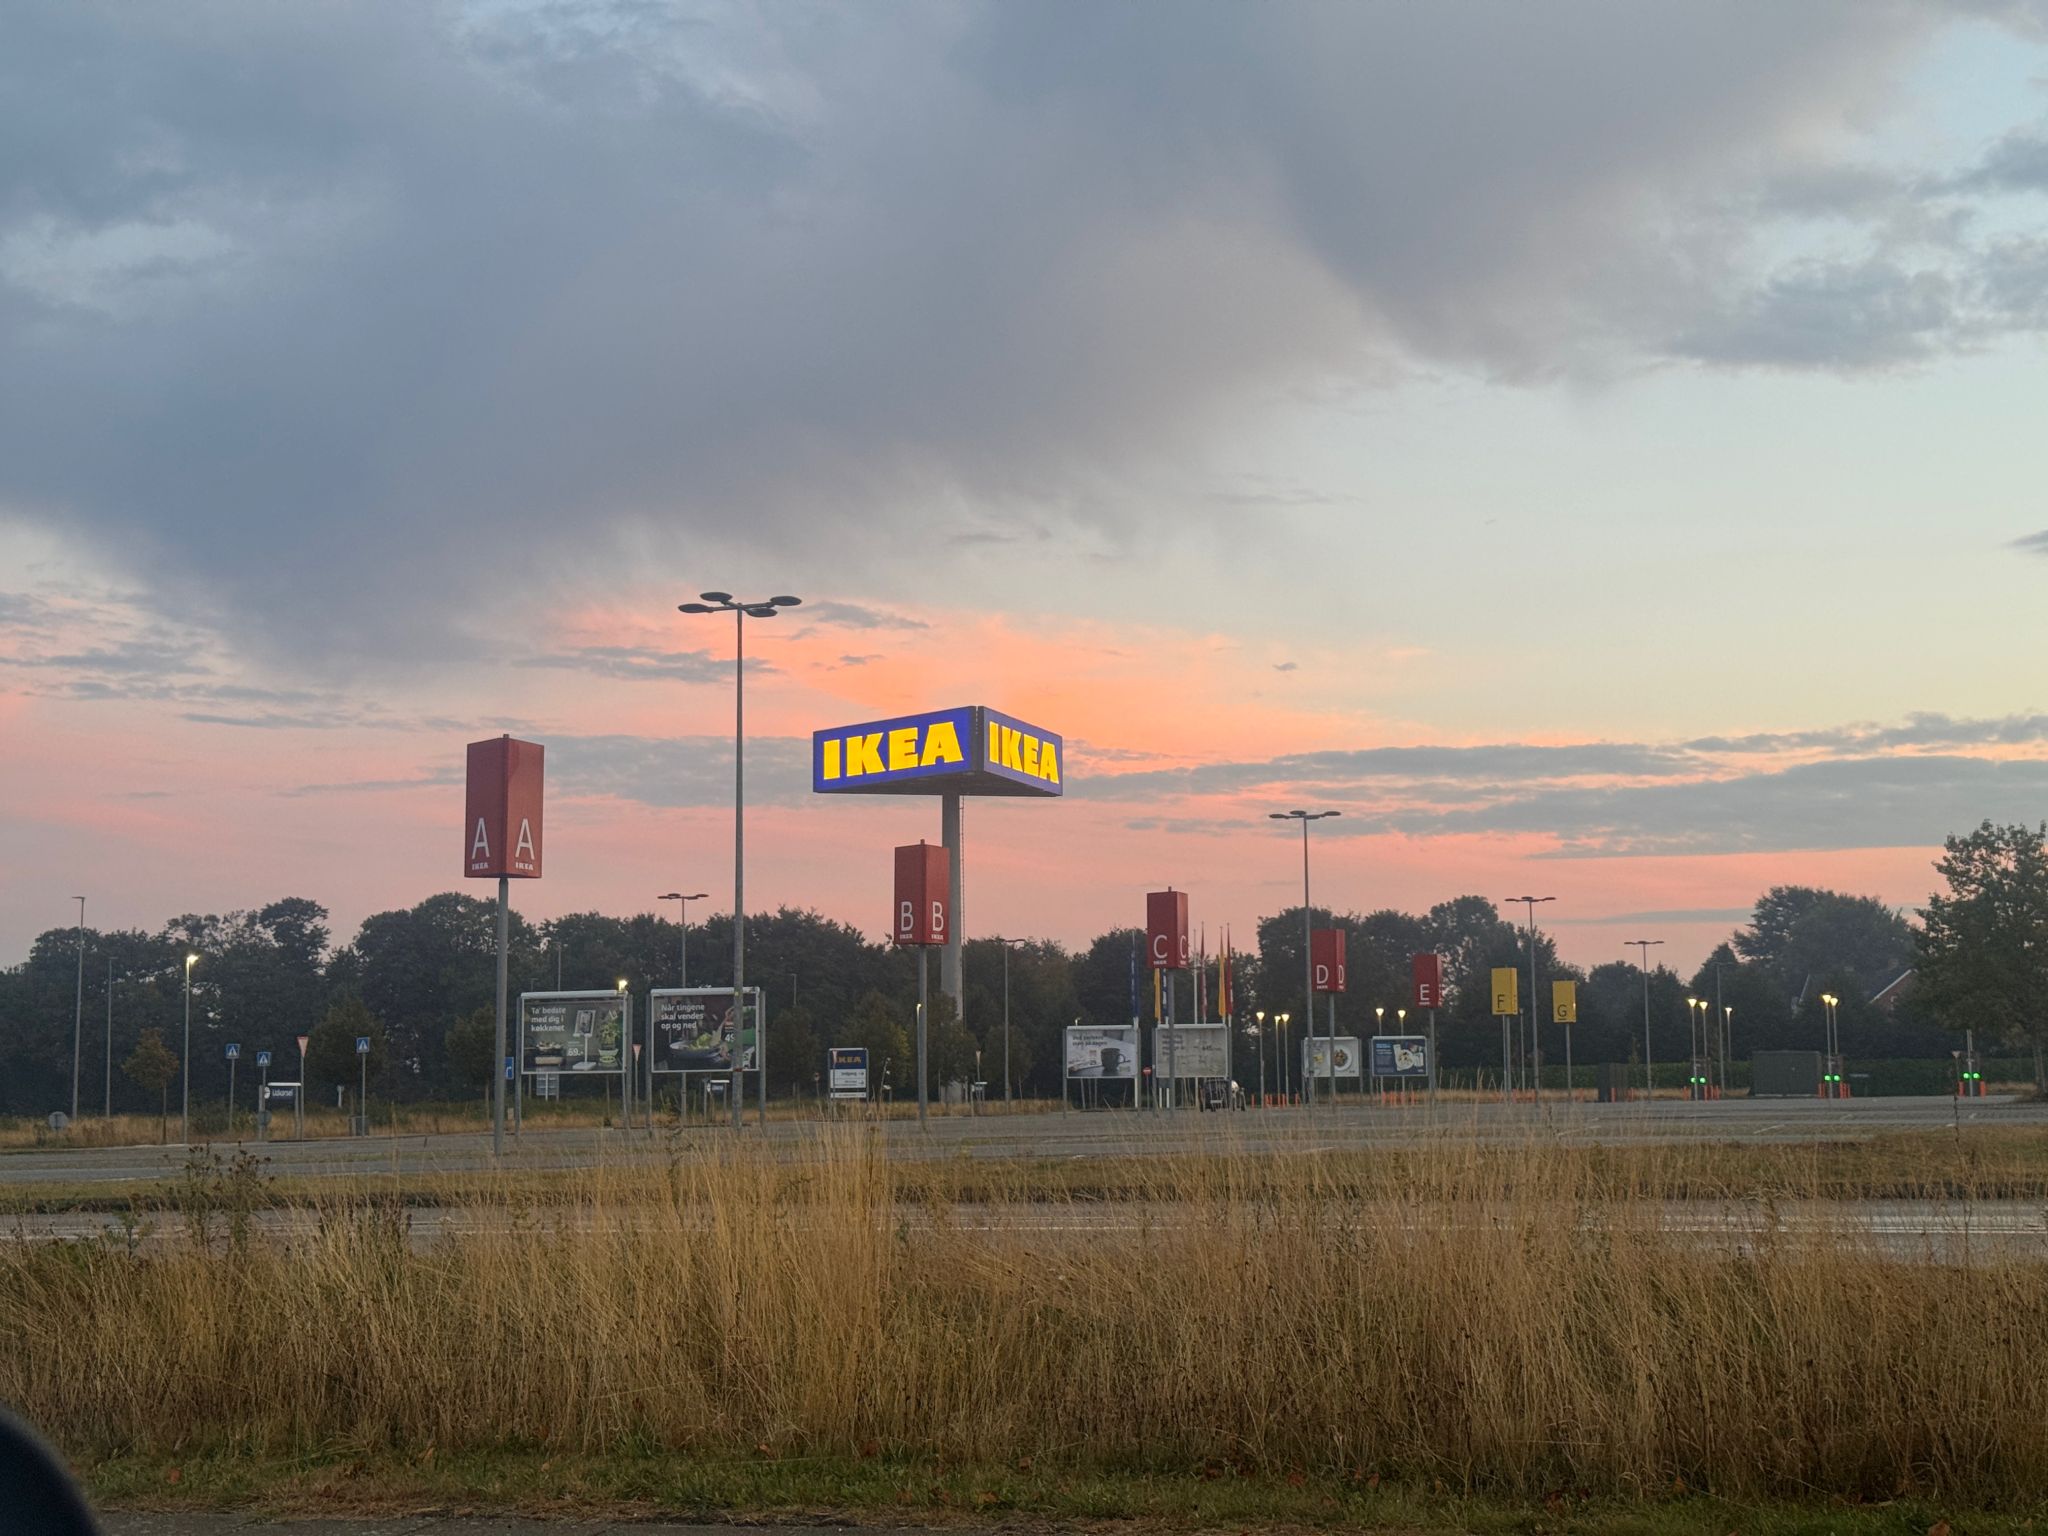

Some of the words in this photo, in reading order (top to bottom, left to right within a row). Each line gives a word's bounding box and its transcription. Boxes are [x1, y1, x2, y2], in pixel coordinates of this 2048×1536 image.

[823, 721, 964, 780] IKEA
[989, 721, 1060, 784] IKEA
[472, 818, 490, 860] A
[515, 818, 535, 860] A
[515, 862, 534, 871] IKEA
[901, 901, 914, 932] B
[932, 901, 944, 932] B
[1153, 934, 1168, 959] C
[1180, 935, 1187, 959] C
[1316, 964, 1329, 984] D
[1338, 964, 1345, 984] D
[1420, 983, 1430, 1001] E
[1497, 994, 1505, 1009] F
[661, 1003, 675, 1011] Når
[676, 1003, 705, 1012] tingene
[1557, 1004, 1567, 1017] G
[531, 1015, 547, 1023] med
[548, 1015, 560, 1024] dig
[661, 1023, 671, 1031] op
[671, 1023, 682, 1031] og
[682, 1021, 697, 1029] ned
